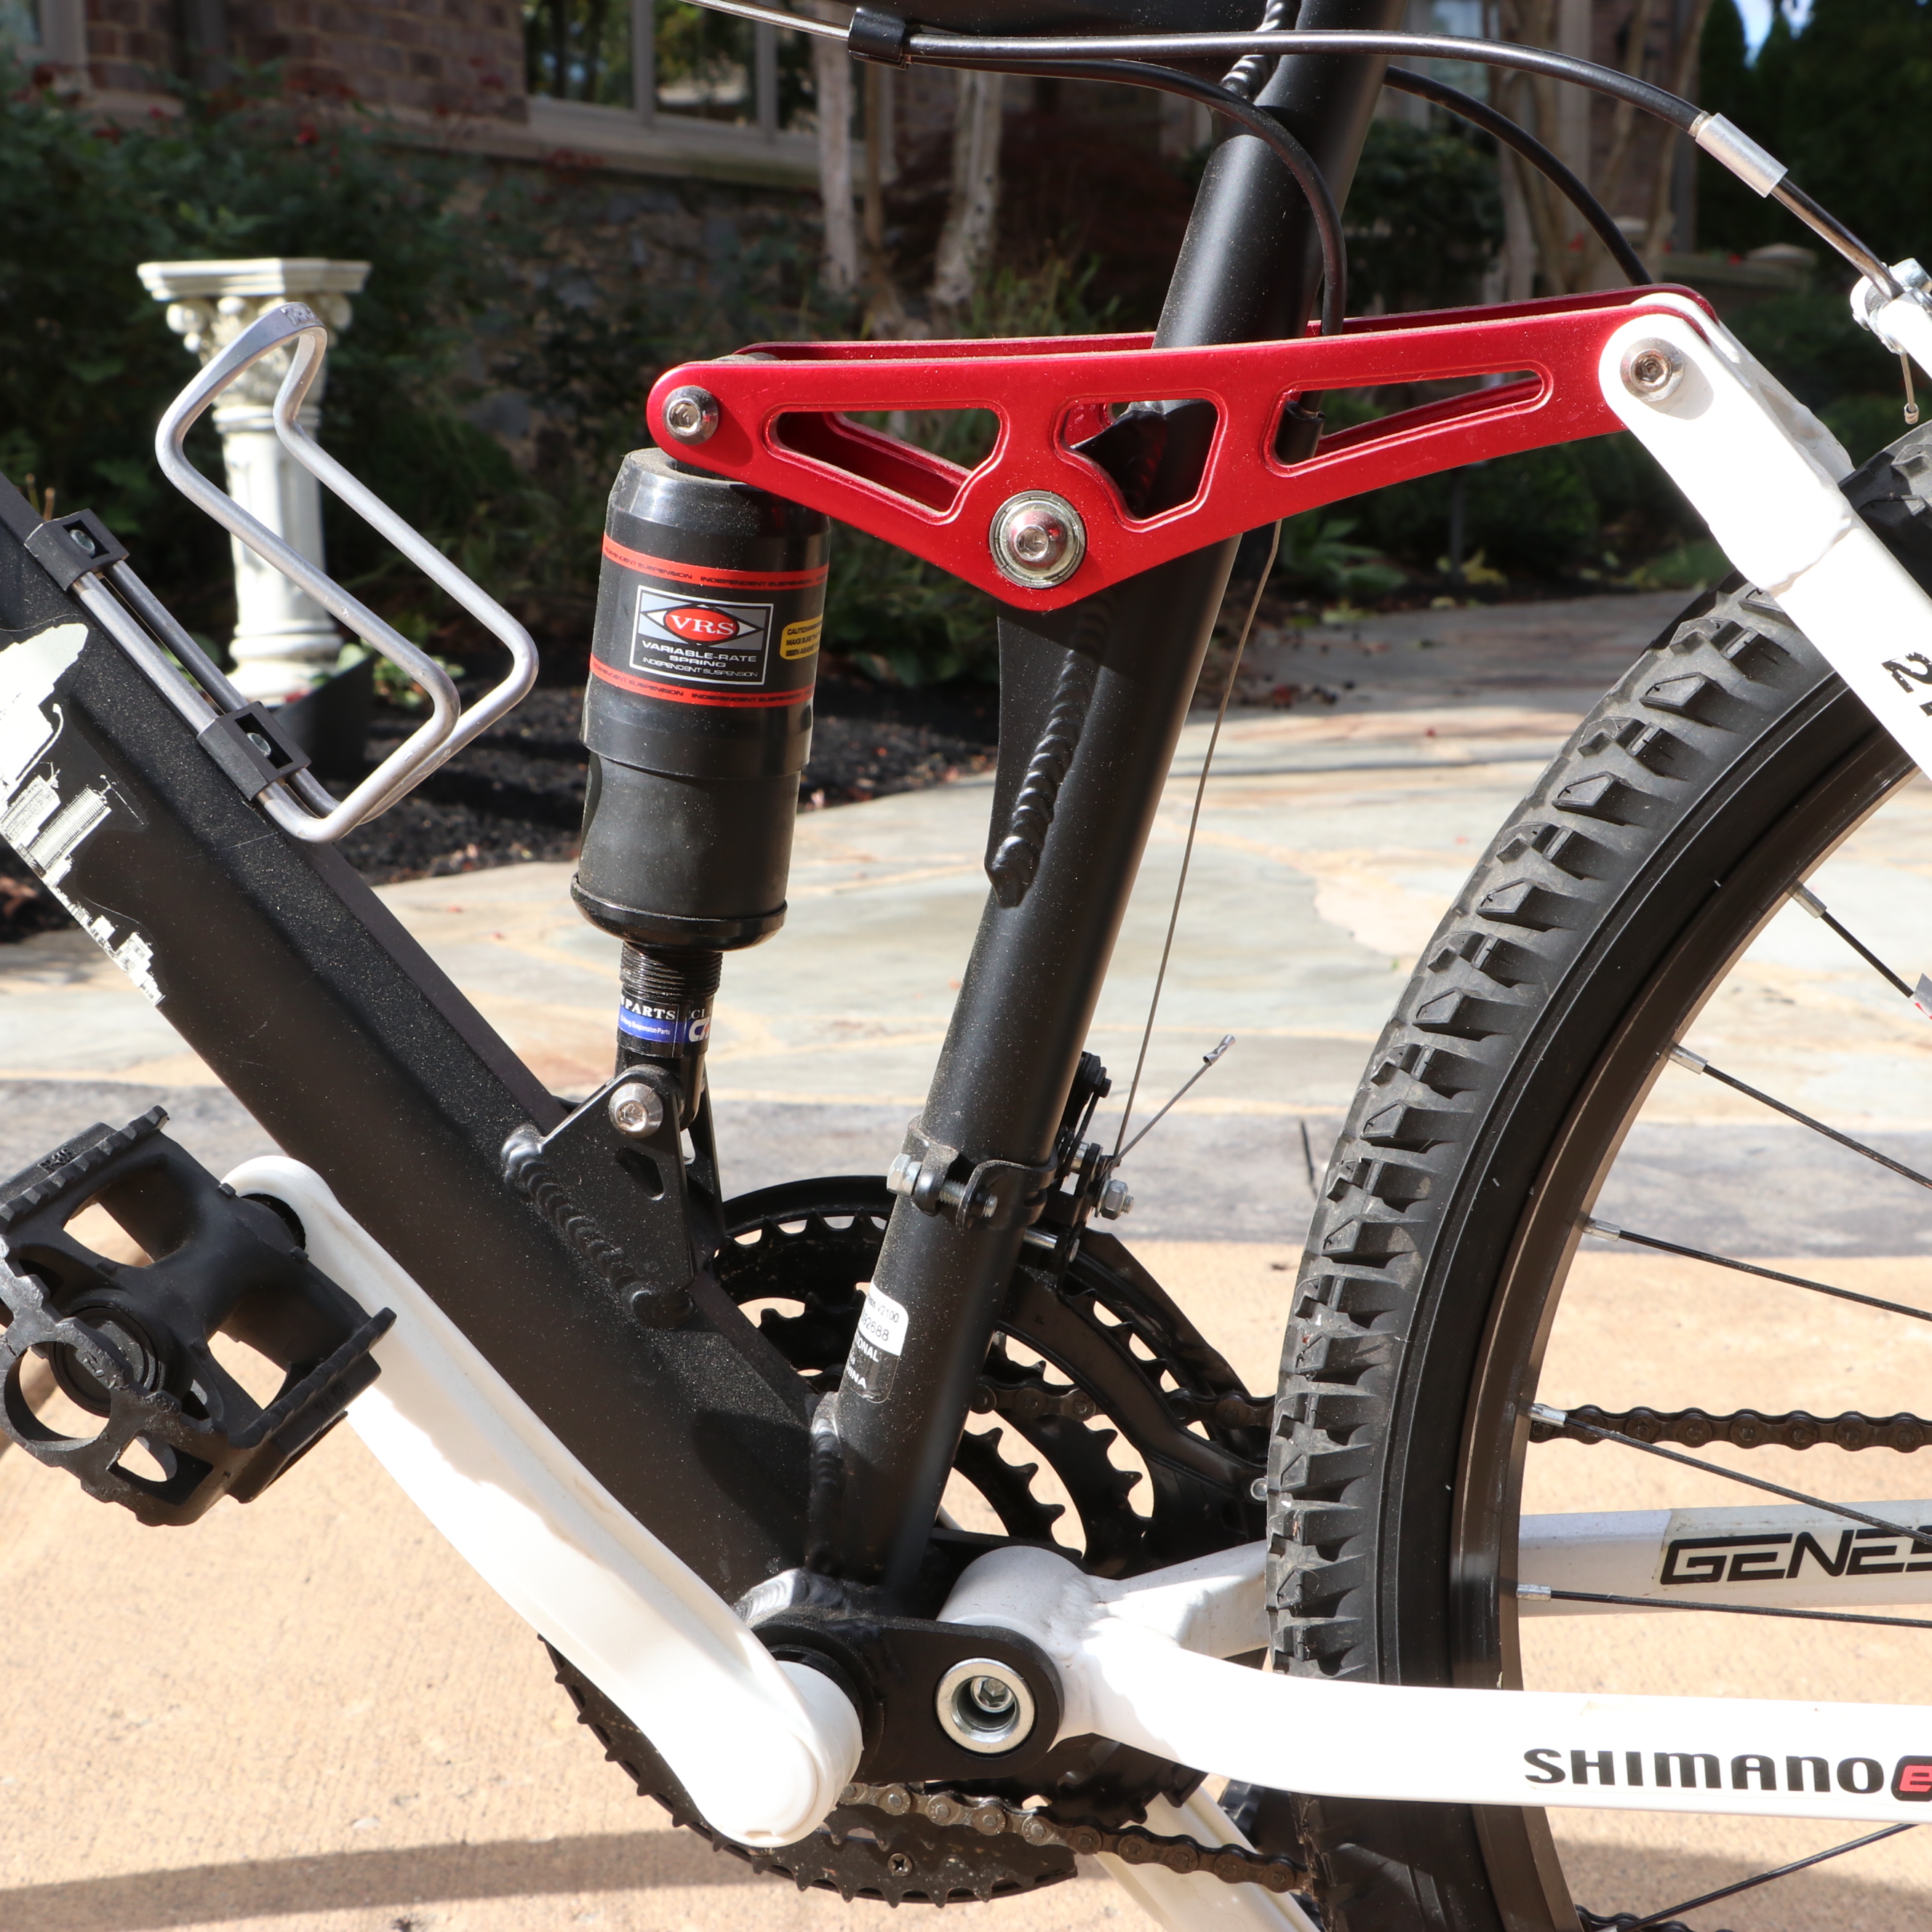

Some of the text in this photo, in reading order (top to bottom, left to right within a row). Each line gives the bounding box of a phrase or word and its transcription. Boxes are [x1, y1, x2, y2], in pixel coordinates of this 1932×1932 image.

[638, 562, 692, 579] SUSPENSION
[669, 614, 735, 636] VRS
[642, 639, 757, 663] VARIABLE-RATE
[668, 655, 726, 668] SPRING
[642, 657, 758, 677] INDEPENDENT SUSPENSION
[628, 679, 684, 696] SUSPENSION
[625, 997, 676, 1021] PARTS
[877, 1301, 899, 1323] V2100
[1523, 1748, 1885, 1795] SHIMANO
